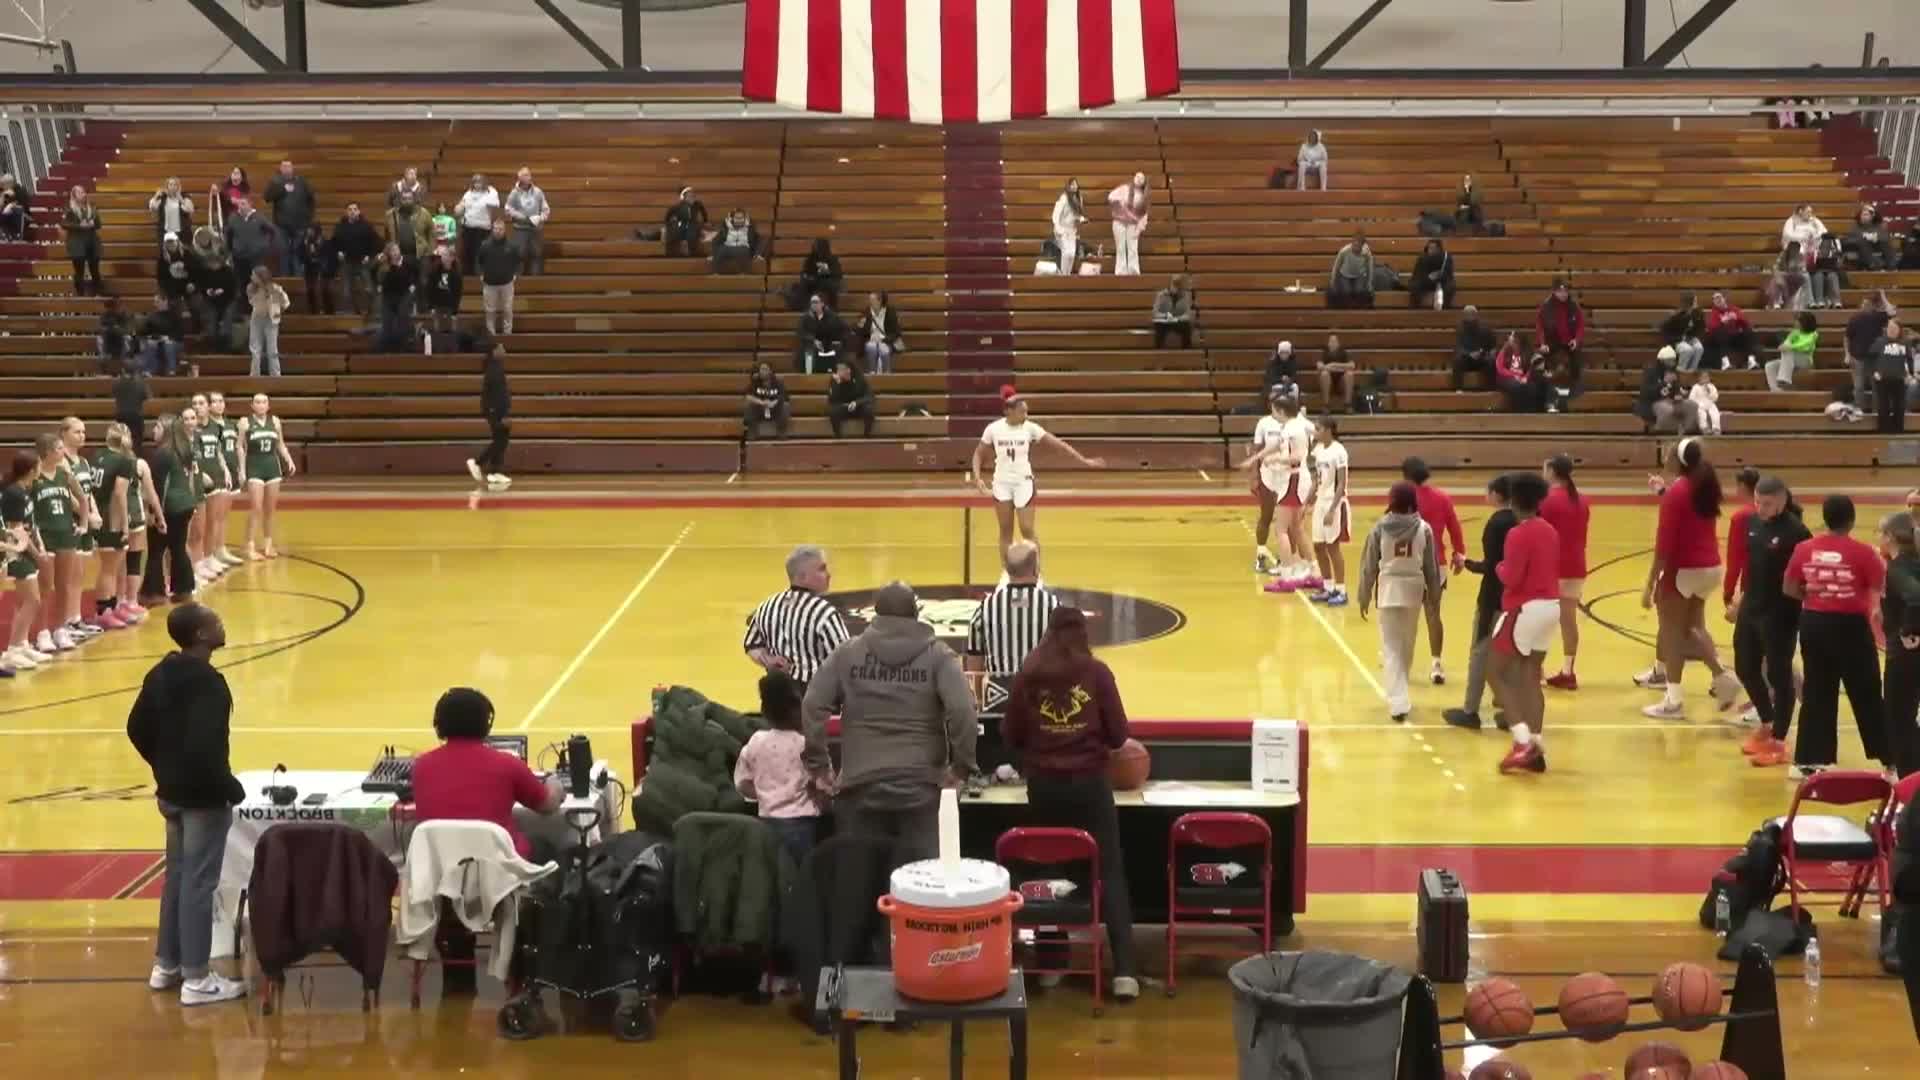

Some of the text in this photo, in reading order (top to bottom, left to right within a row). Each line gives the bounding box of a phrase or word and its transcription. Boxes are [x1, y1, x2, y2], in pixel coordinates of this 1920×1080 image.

[51, 500, 64, 515] 31
[850, 665, 928, 683] CHAMPIONS
[239, 807, 334, 820] BROCKTON
